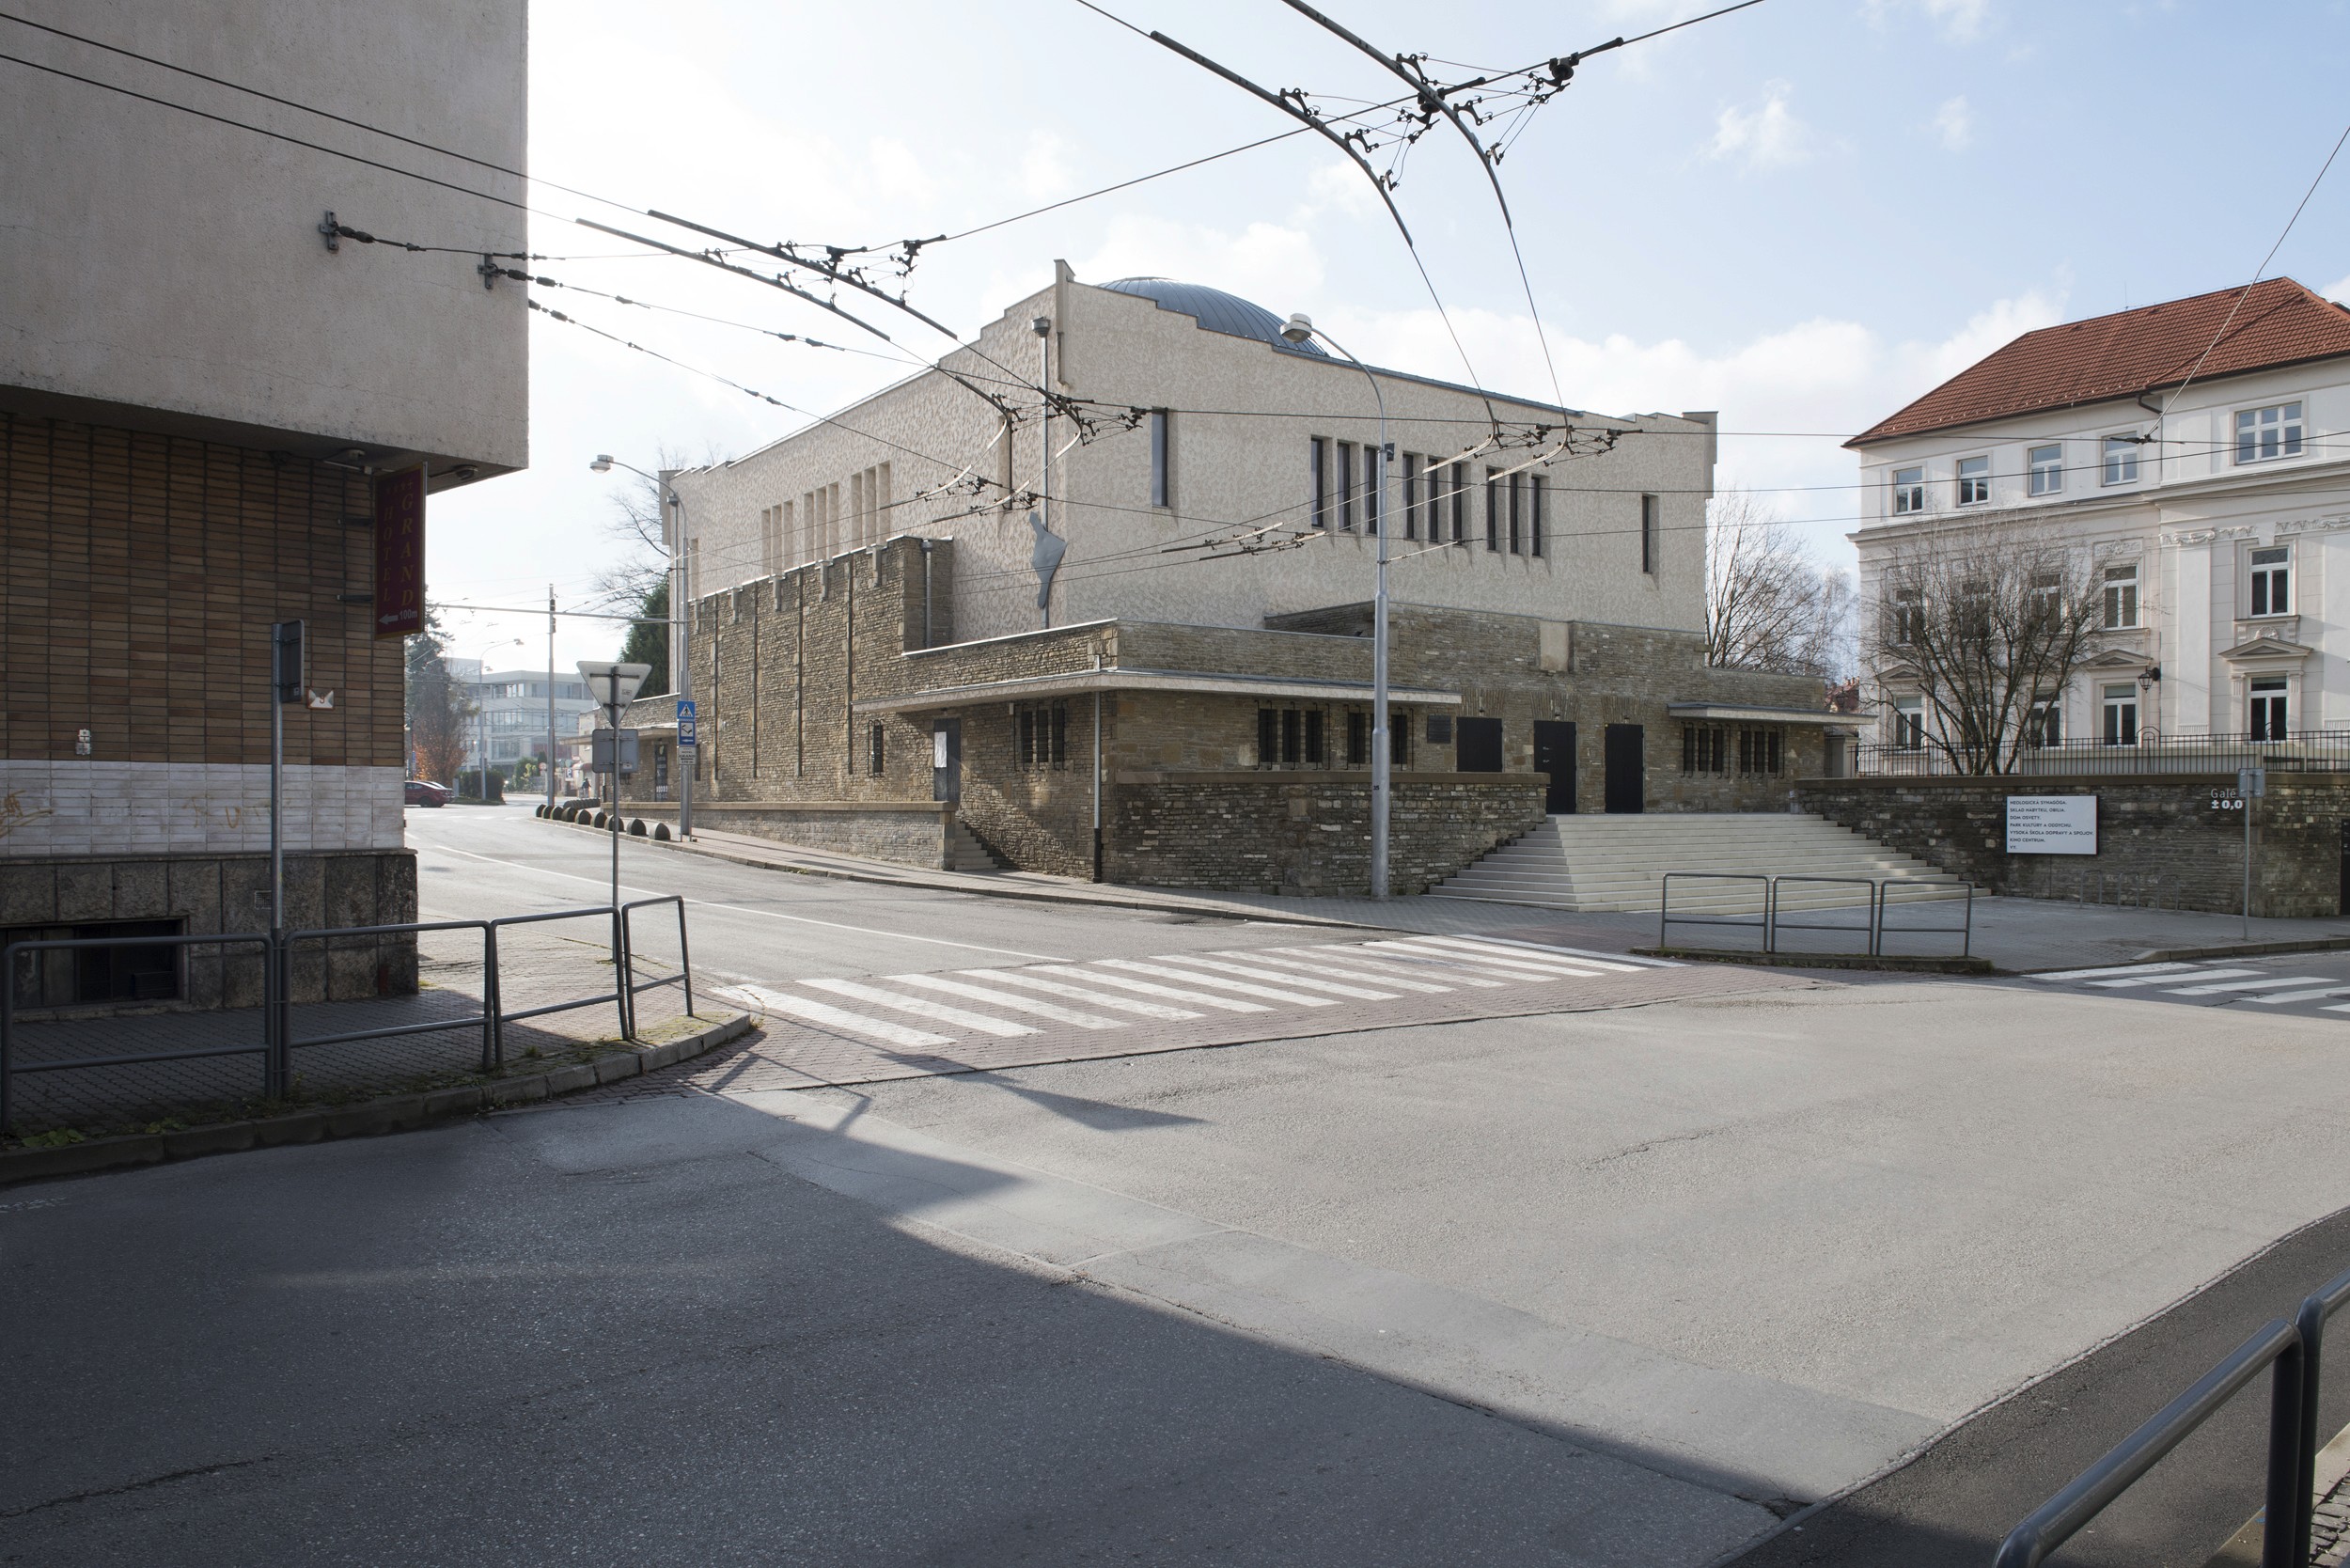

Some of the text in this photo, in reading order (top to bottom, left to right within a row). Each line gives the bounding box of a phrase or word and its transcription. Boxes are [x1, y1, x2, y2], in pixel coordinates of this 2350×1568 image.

[383, 506, 393, 602] HOTEL
[400, 493, 415, 606] GRAND
[2211, 788, 2236, 798] Galé
